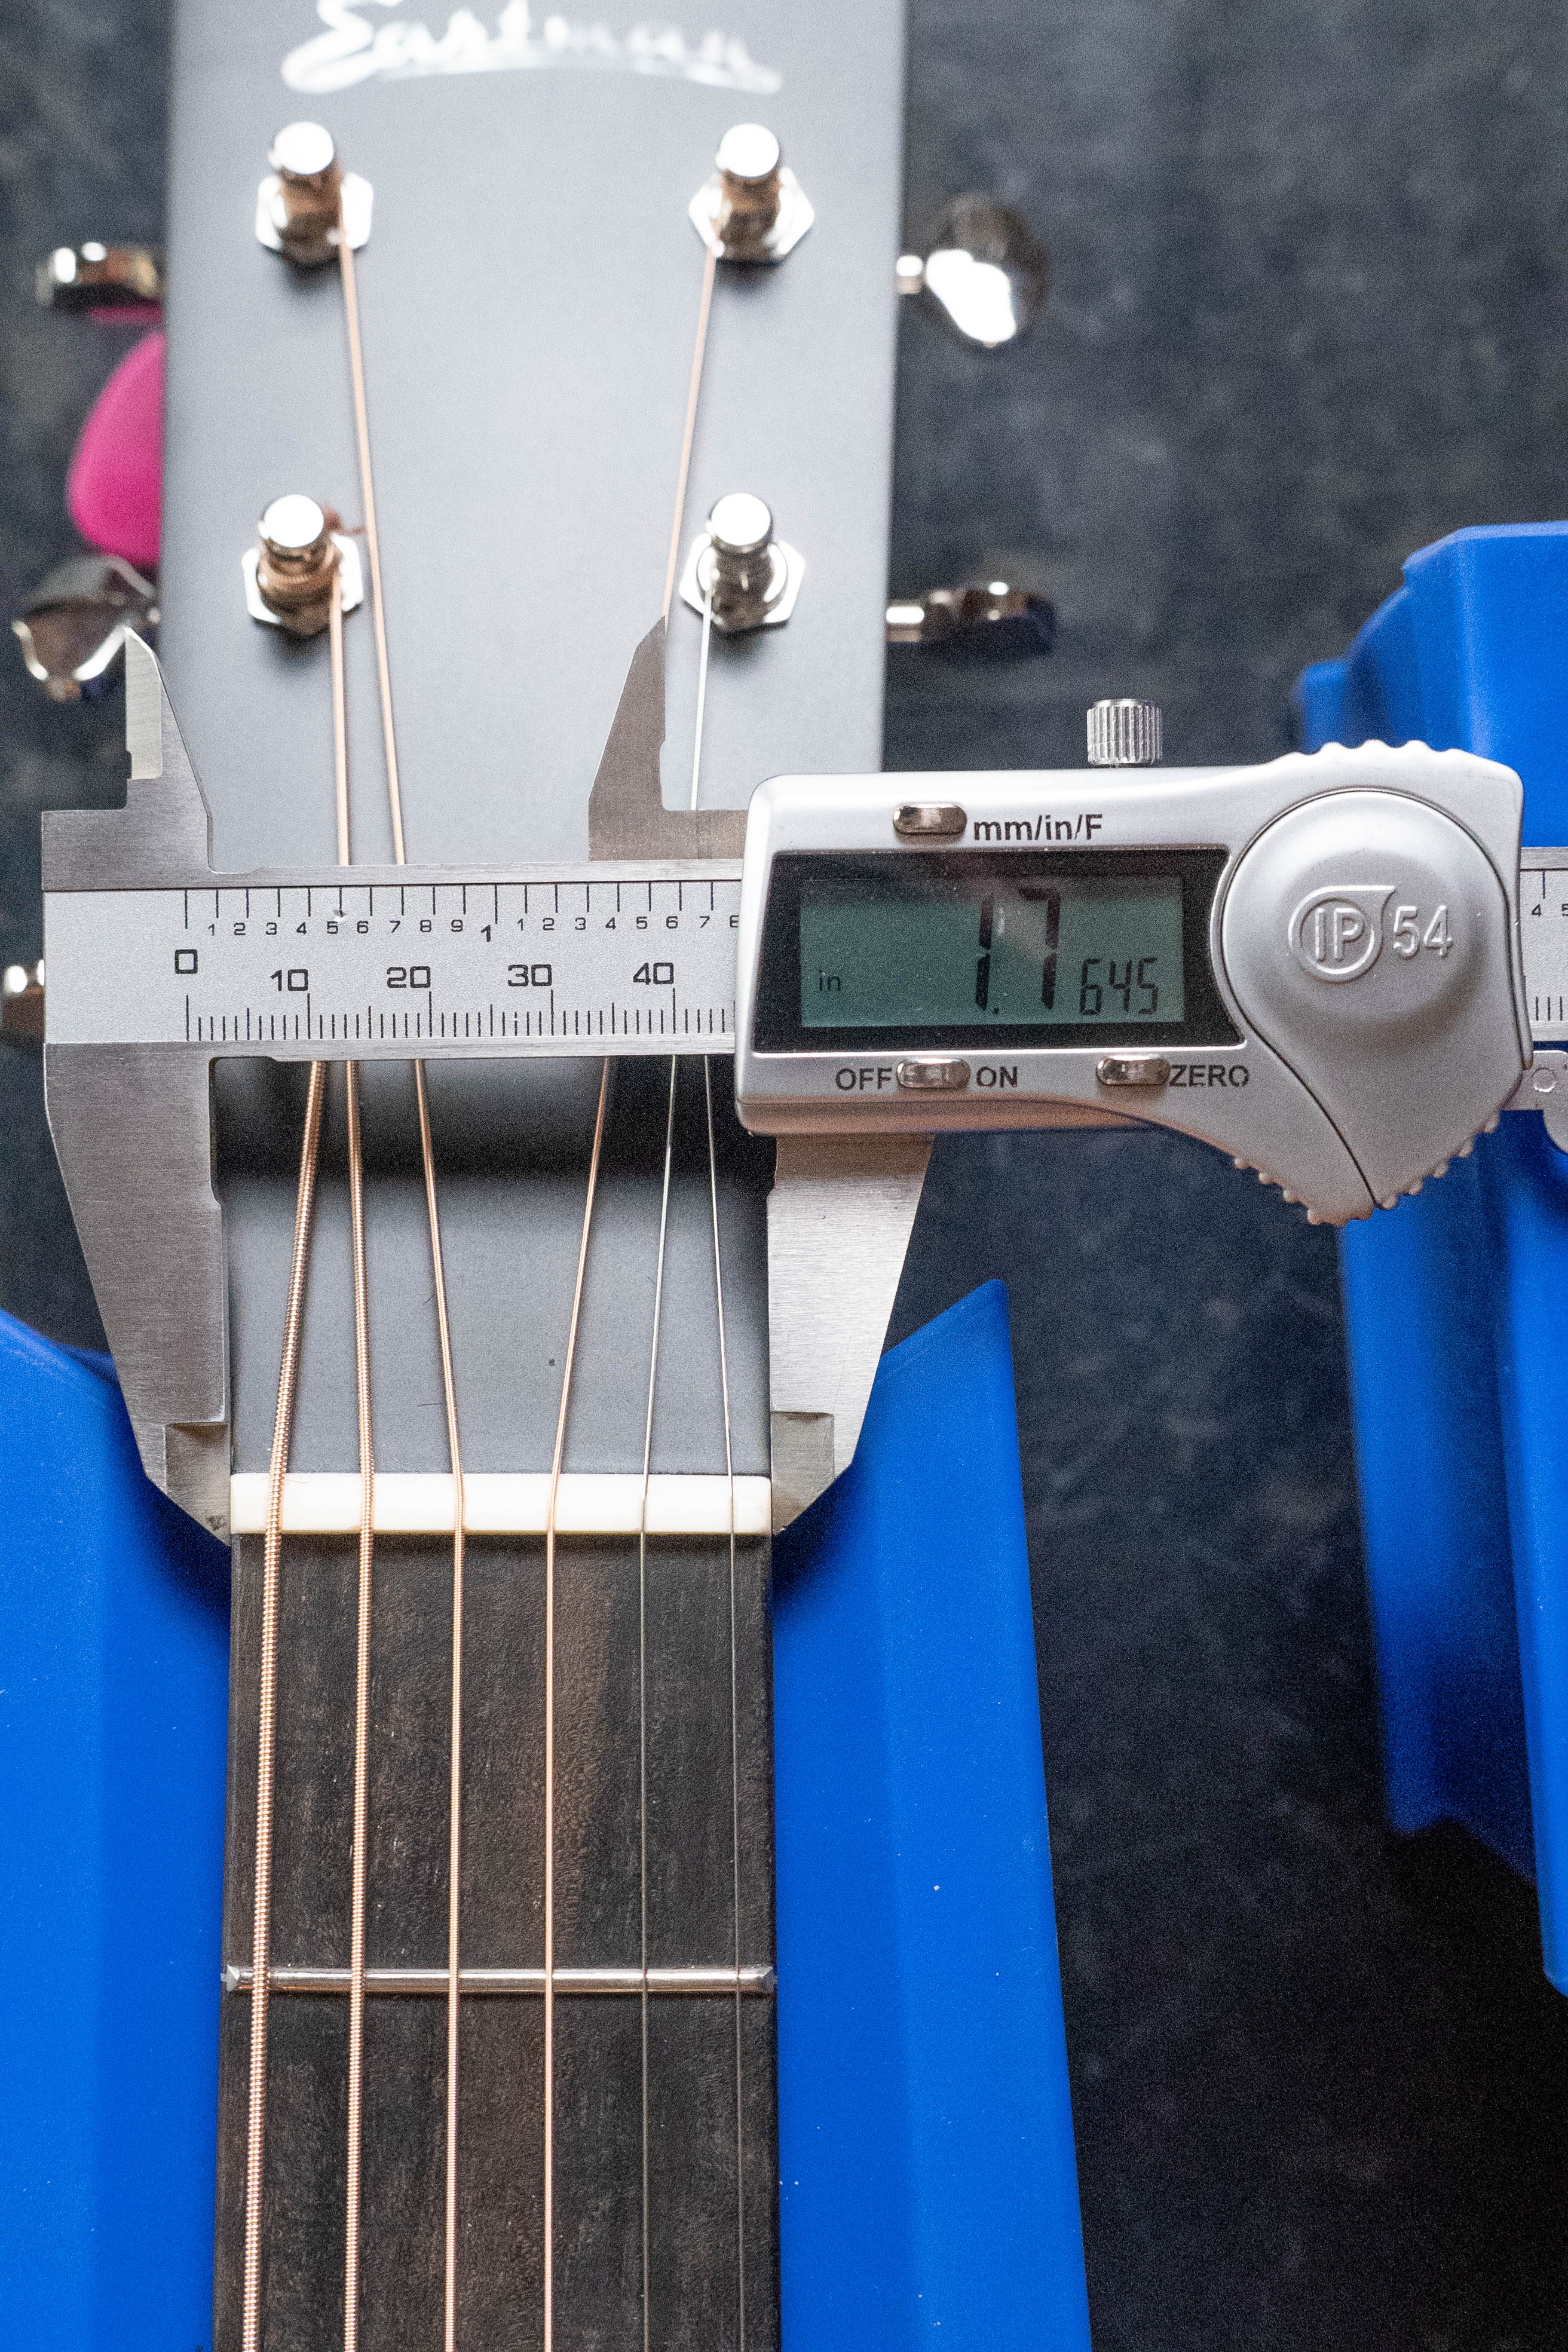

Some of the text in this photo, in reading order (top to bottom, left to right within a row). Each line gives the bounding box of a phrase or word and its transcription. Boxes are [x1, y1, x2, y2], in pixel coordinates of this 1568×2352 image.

[973, 814, 1102, 841] mm/in/F
[1531, 904, 1542, 917] 4
[208, 923, 215, 936] 1
[233, 922, 246, 936] 2
[265, 922, 277, 935] 3
[296, 921, 307, 935] 4
[327, 921, 339, 935] 5
[356, 920, 369, 934] 6
[390, 920, 401, 933] 7
[419, 920, 432, 933] 8
[451, 919, 463, 933] 9
[480, 924, 491, 942] 1
[517, 918, 523, 931] 1
[542, 917, 555, 931] 2
[575, 917, 586, 930] 3
[605, 917, 616, 930] 4
[636, 916, 648, 929] 5
[666, 915, 678, 929] 6
[699, 915, 710, 928] 7
[1316, 905, 1453, 962] IP 54
[174, 948, 675, 992] 0 10 20 30 40
[819, 969, 840, 992] in
[835, 1067, 893, 1091] OFF
[976, 1066, 1018, 1088] ON
[1169, 1064, 1250, 1087] ZERO
